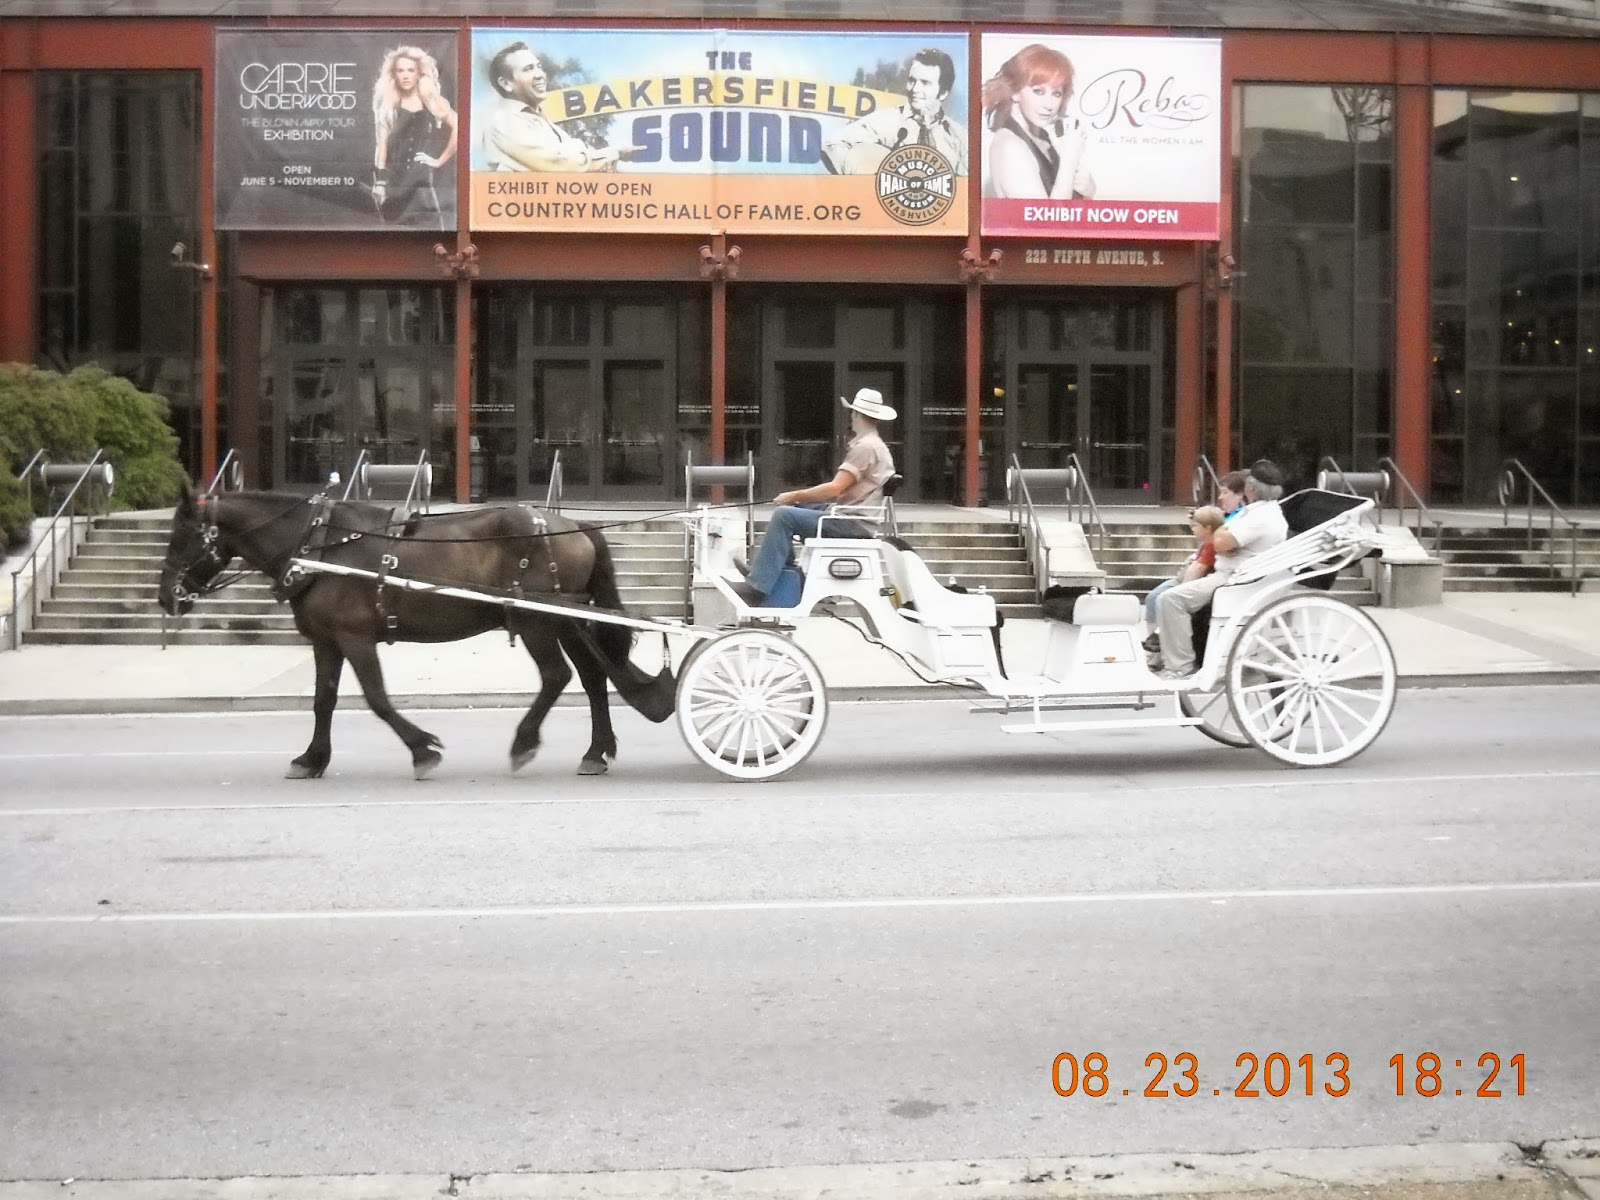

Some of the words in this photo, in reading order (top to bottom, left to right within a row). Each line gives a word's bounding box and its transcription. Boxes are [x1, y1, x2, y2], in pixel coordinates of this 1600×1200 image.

[706, 51, 751, 70] THE
[240, 62, 357, 93] CARRIE
[240, 93, 357, 110] UNDERWOOD
[563, 77, 876, 118] BAKERSFIELD
[1080, 69, 1212, 130] Reba
[242, 118, 260, 128] THE
[261, 118, 299, 128] BLOWN
[328, 118, 356, 128] TOUR
[264, 129, 334, 141] EXHIBITION
[632, 111, 822, 164] SOUND
[1098, 136, 1116, 144] ALL
[1119, 136, 1138, 144] THE
[1142, 137, 1180, 145] WOMEN
[1188, 137, 1204, 145] AM
[888, 150, 946, 171] COUNTRY
[898, 161, 935, 175] MUSIC
[283, 165, 312, 175] OPEN
[240, 177, 267, 186] JUNE
[269, 177, 276, 186] 5
[284, 177, 341, 187] NOVEMBER
[343, 177, 355, 186] 10
[488, 181, 549, 195] EXHIBIT
[556, 182, 599, 196] NOW
[606, 182, 652, 196] OPEN
[880, 172, 908, 196] HALL
[910, 181, 922, 189] OF
[924, 174, 952, 198] FAME
[887, 199, 945, 219] NASHVILLE
[897, 193, 935, 209] MUSEUM
[1023, 207, 1083, 222] EXHIBIT
[1087, 208, 1129, 222] NOW
[1133, 208, 1179, 224] OPEN
[1025, 250, 1047, 264] 222
[1053, 250, 1091, 264] FIFTH
[1096, 250, 1148, 267] AVENUE,
[1152, 251, 1164, 265] S.
